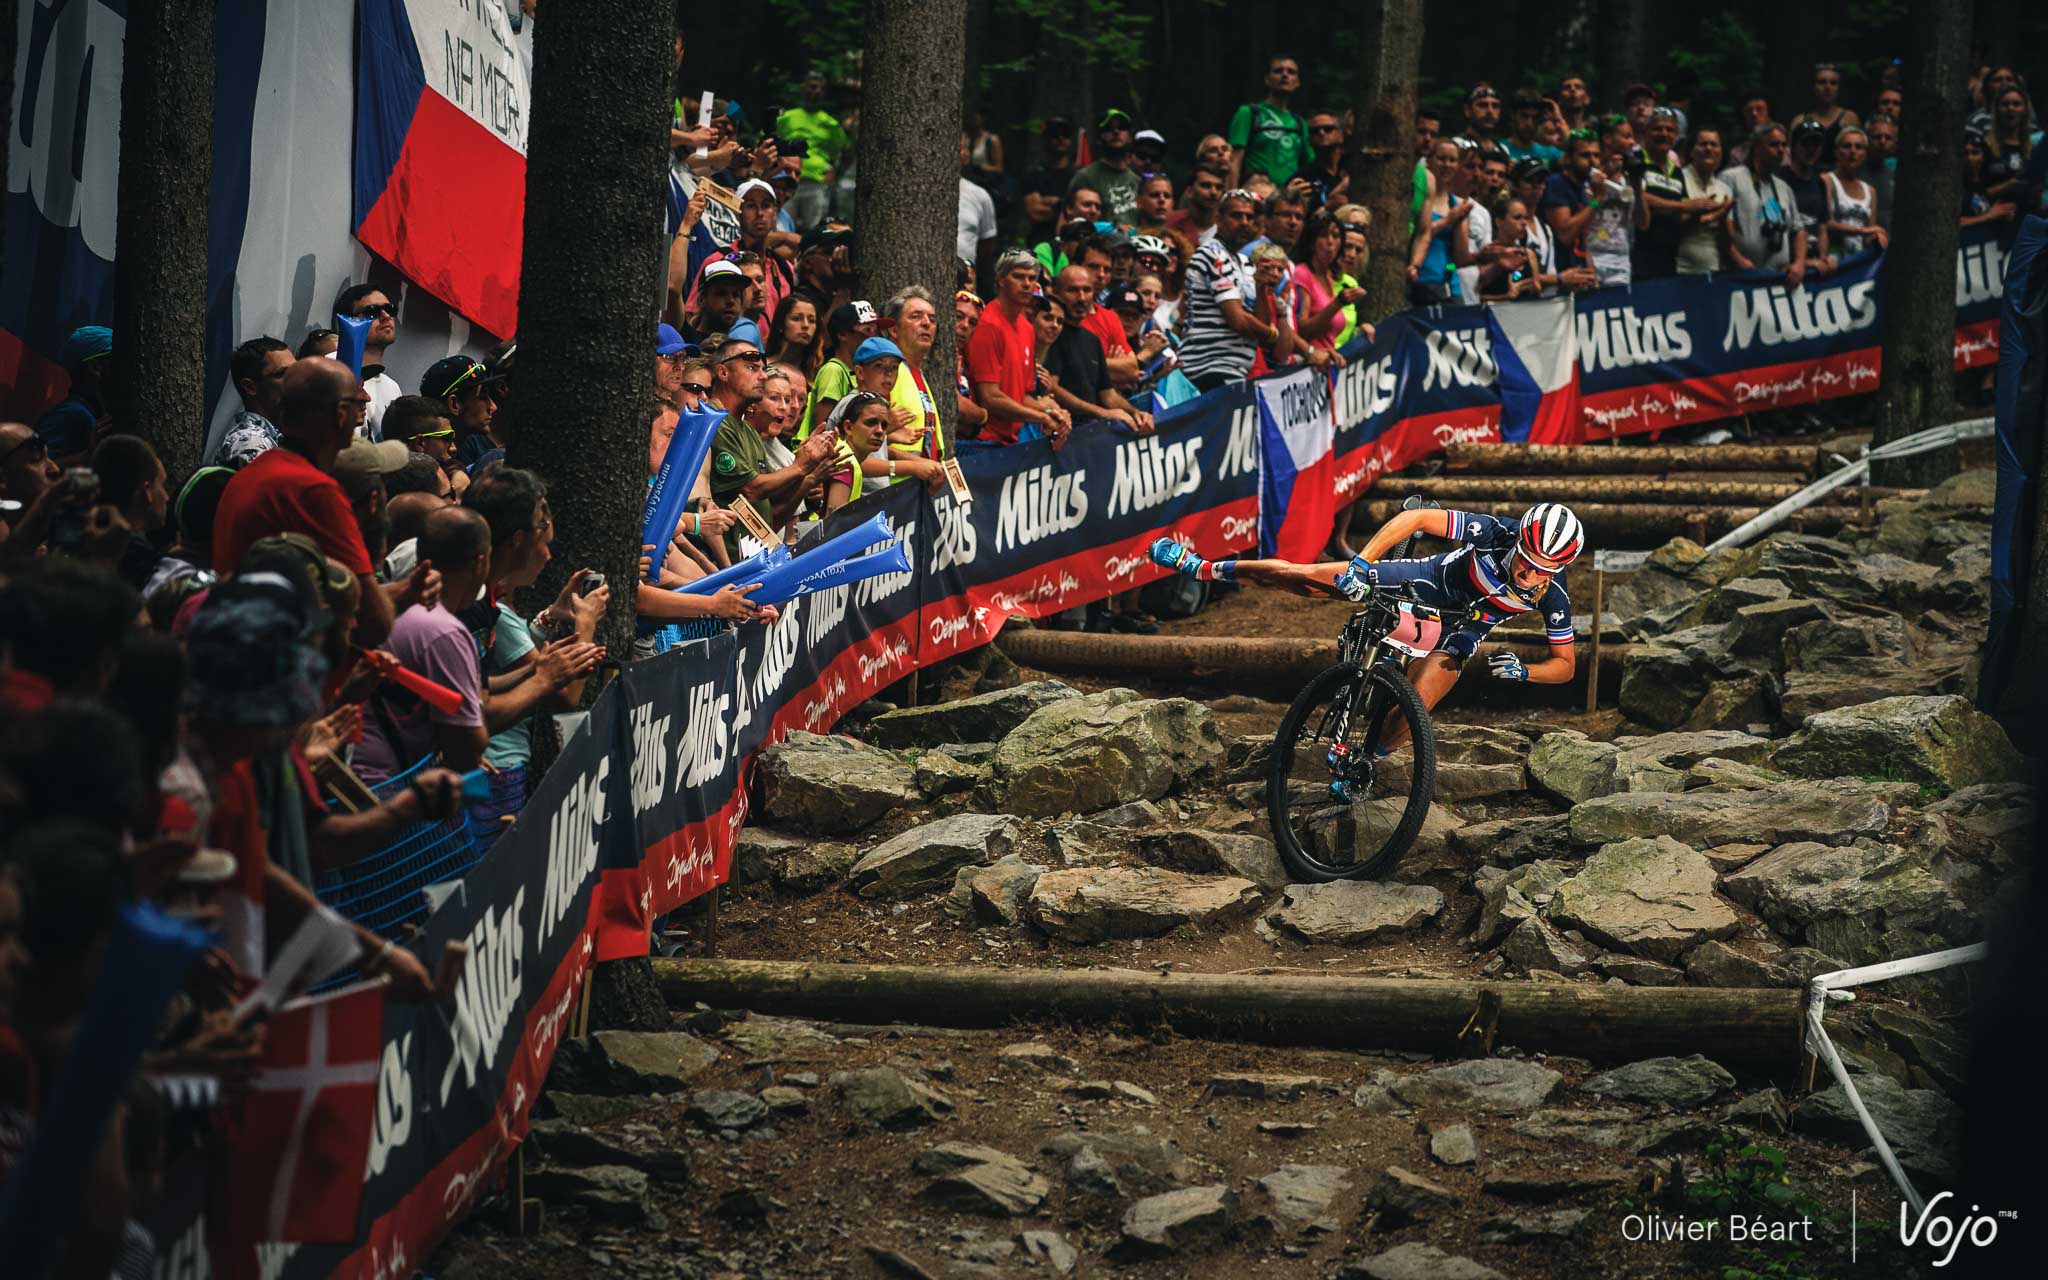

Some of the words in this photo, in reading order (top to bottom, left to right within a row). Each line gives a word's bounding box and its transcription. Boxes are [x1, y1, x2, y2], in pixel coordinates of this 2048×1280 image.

[445, 29, 473, 112] NA
[480, 52, 525, 149] MOR
[1576, 306, 1692, 373] Mitas
[1723, 280, 1876, 352] Mitas
[1422, 327, 1496, 392] Mit
[1734, 369, 1804, 403] Designed
[1811, 365, 1842, 396] for
[1849, 361, 1878, 388] You
[1641, 390, 1669, 425] for
[995, 464, 1088, 553] Mitas
[1107, 435, 1203, 519] Mitas
[930, 605, 972, 648] Designed
[1413, 621, 1422, 643] 1
